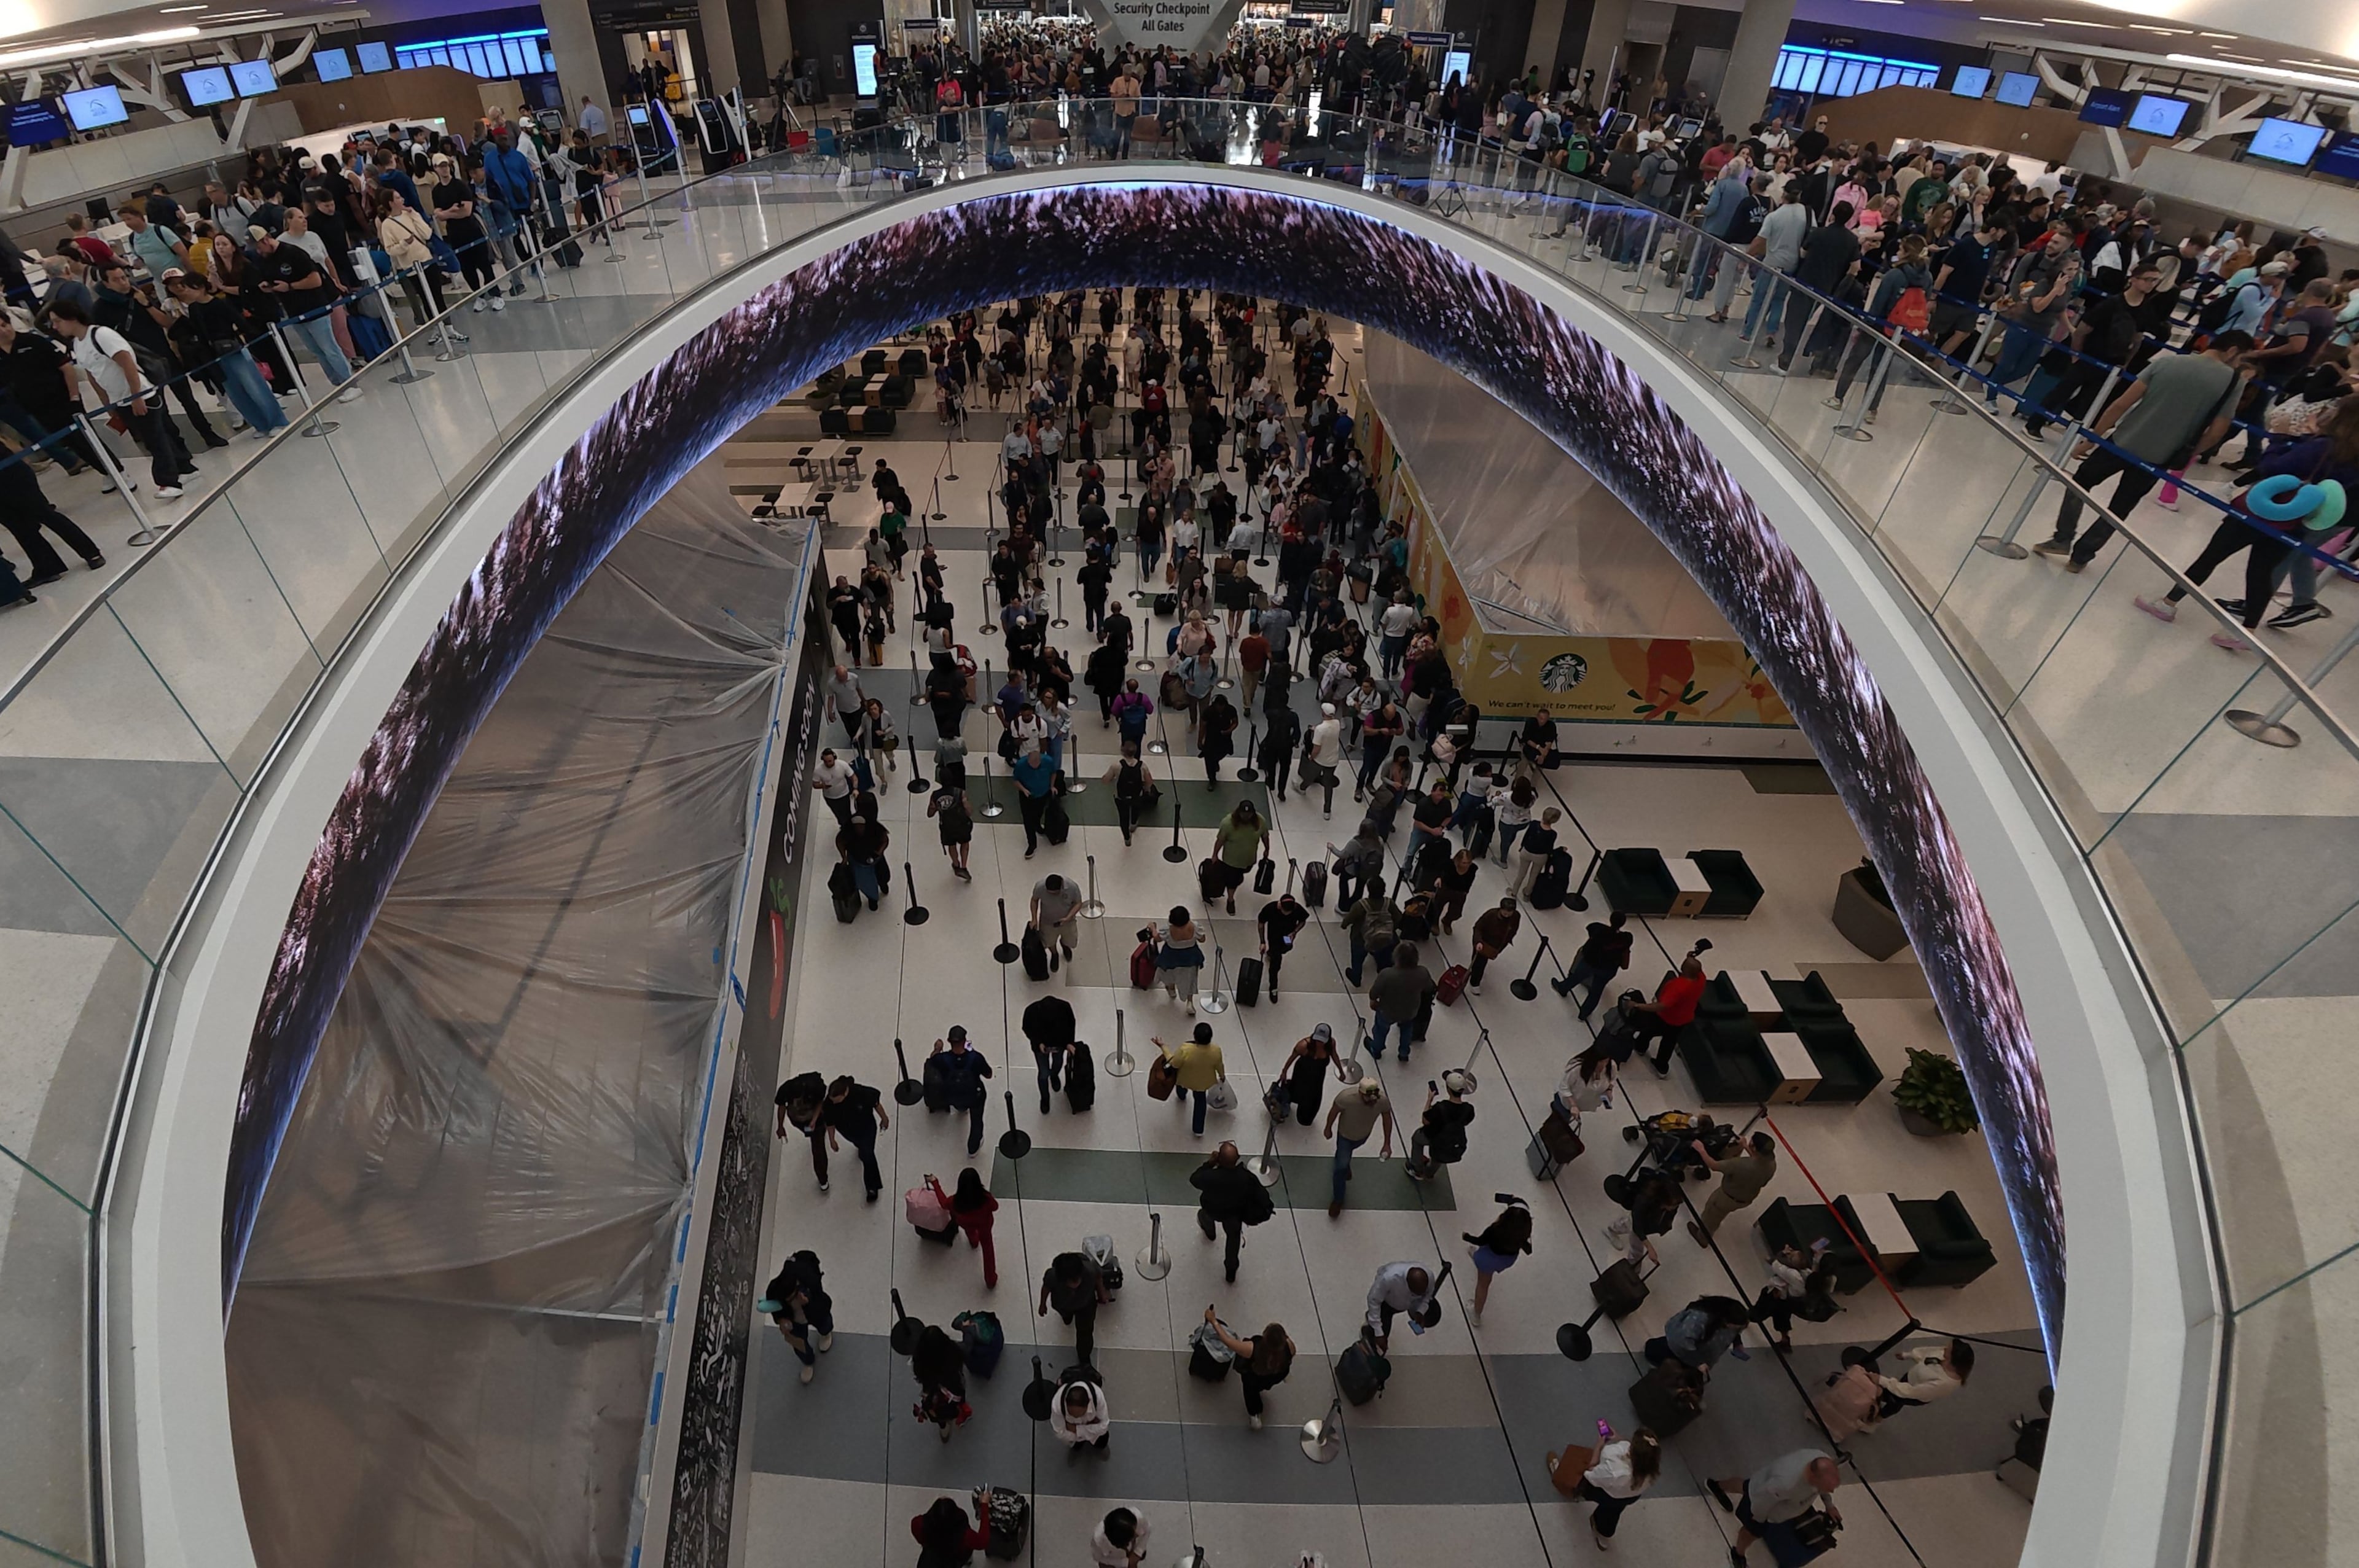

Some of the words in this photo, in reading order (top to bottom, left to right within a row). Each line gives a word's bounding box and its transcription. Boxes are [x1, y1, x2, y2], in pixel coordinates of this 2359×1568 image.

[1114, 2, 1153, 17] Security
[1156, 2, 1210, 18] Checkpoint
[1141, 20, 1155, 31] All
[1157, 20, 1184, 31] Gates
[783, 742, 806, 865] COMING
[800, 674, 816, 751] SOON
